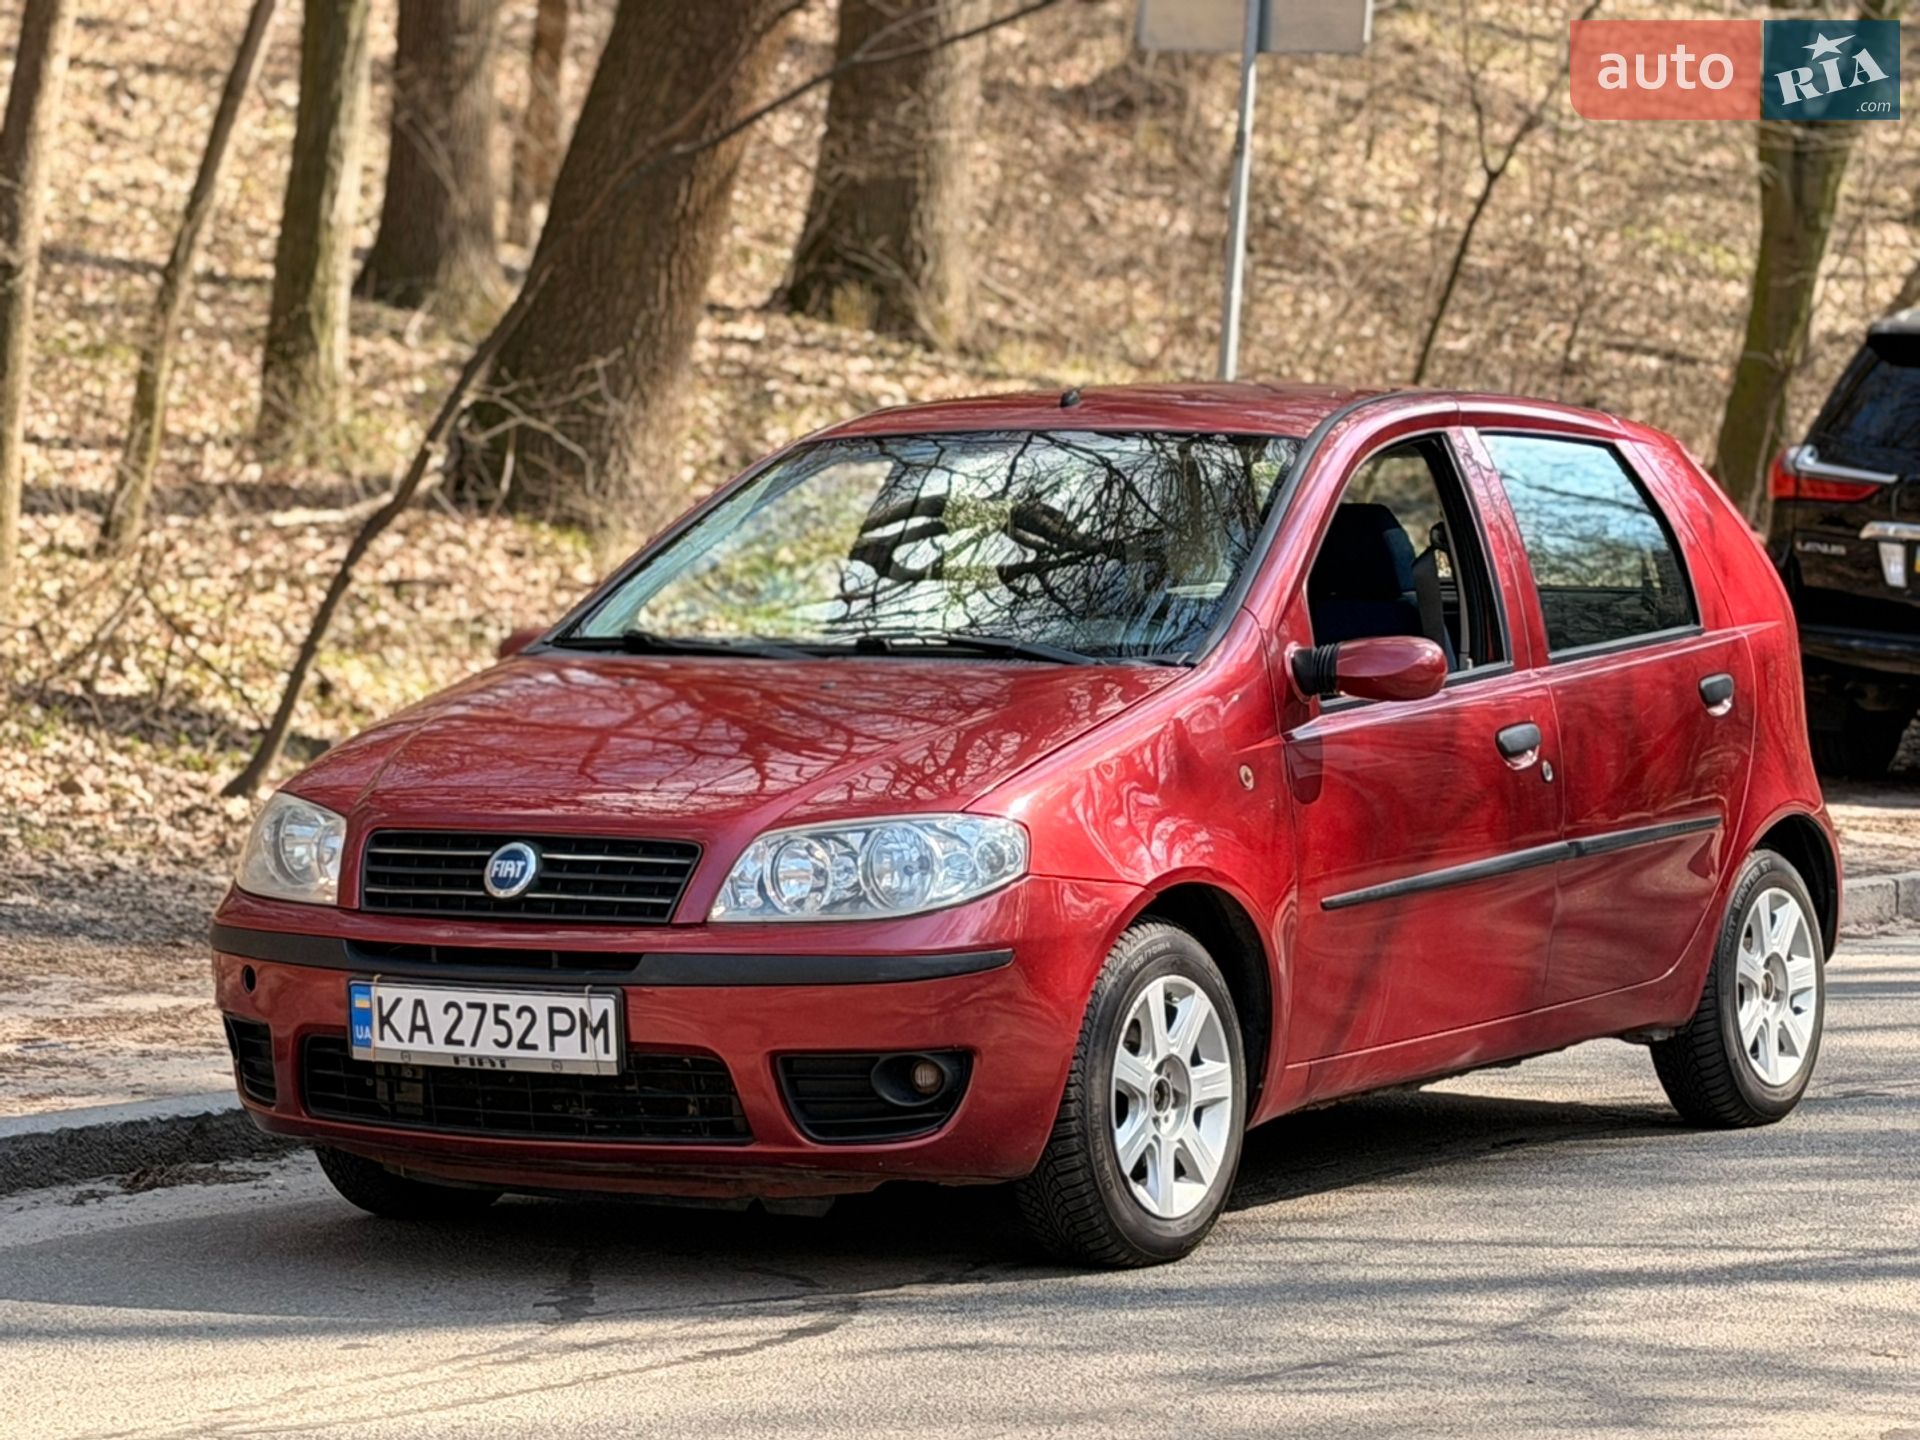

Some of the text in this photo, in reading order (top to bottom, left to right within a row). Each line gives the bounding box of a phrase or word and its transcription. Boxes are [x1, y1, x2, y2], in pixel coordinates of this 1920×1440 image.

[490, 860, 526, 878] FIAT
[355, 1025, 372, 1040] UA
[377, 996, 610, 1055] KA 2752 PM
